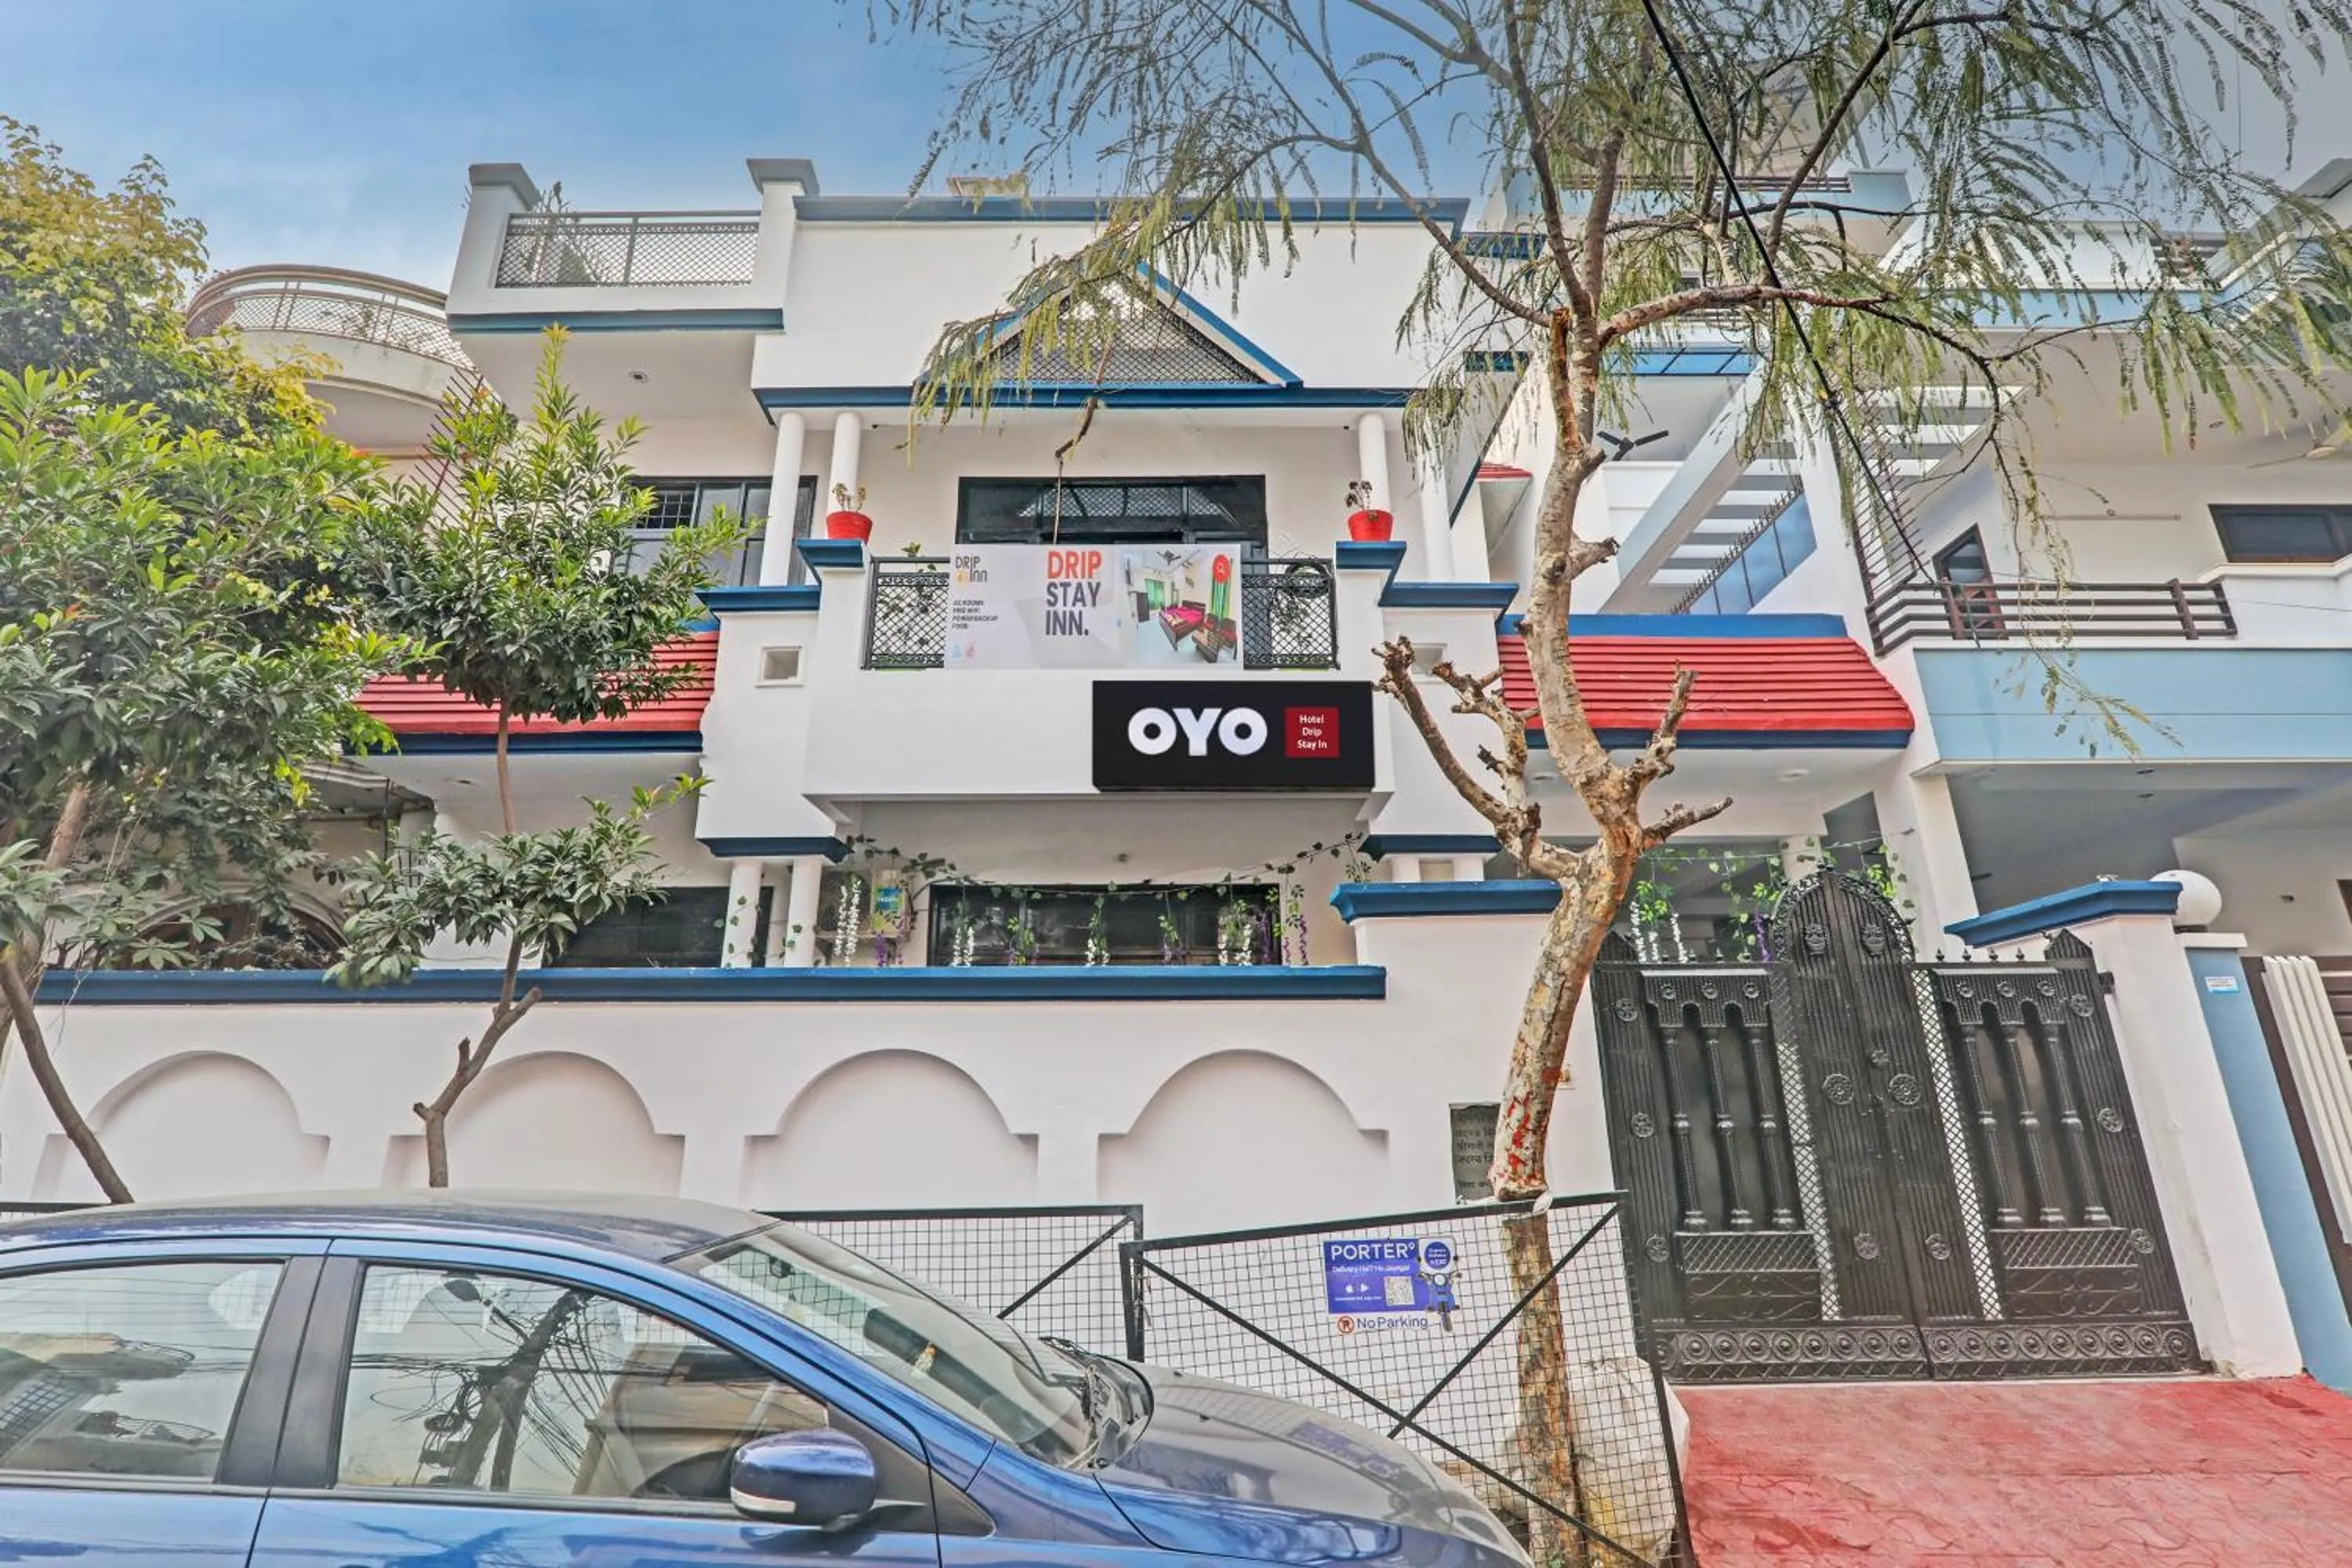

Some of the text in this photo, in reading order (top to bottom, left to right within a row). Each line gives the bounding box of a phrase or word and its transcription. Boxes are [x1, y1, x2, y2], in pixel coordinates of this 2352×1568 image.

[955, 555, 981, 568] DRIP
[1047, 550, 1102, 579] DRIP
[1046, 582, 1102, 608] STAY
[1045, 610, 1090, 637] INN.
[1299, 714, 1325, 724] Hotel
[1127, 707, 1268, 757] OYO
[1302, 727, 1323, 737] Drip
[1298, 739, 1327, 750] Stay In
[1330, 1243, 1409, 1261] PORTER
[1357, 1315, 1428, 1330] No Parking
